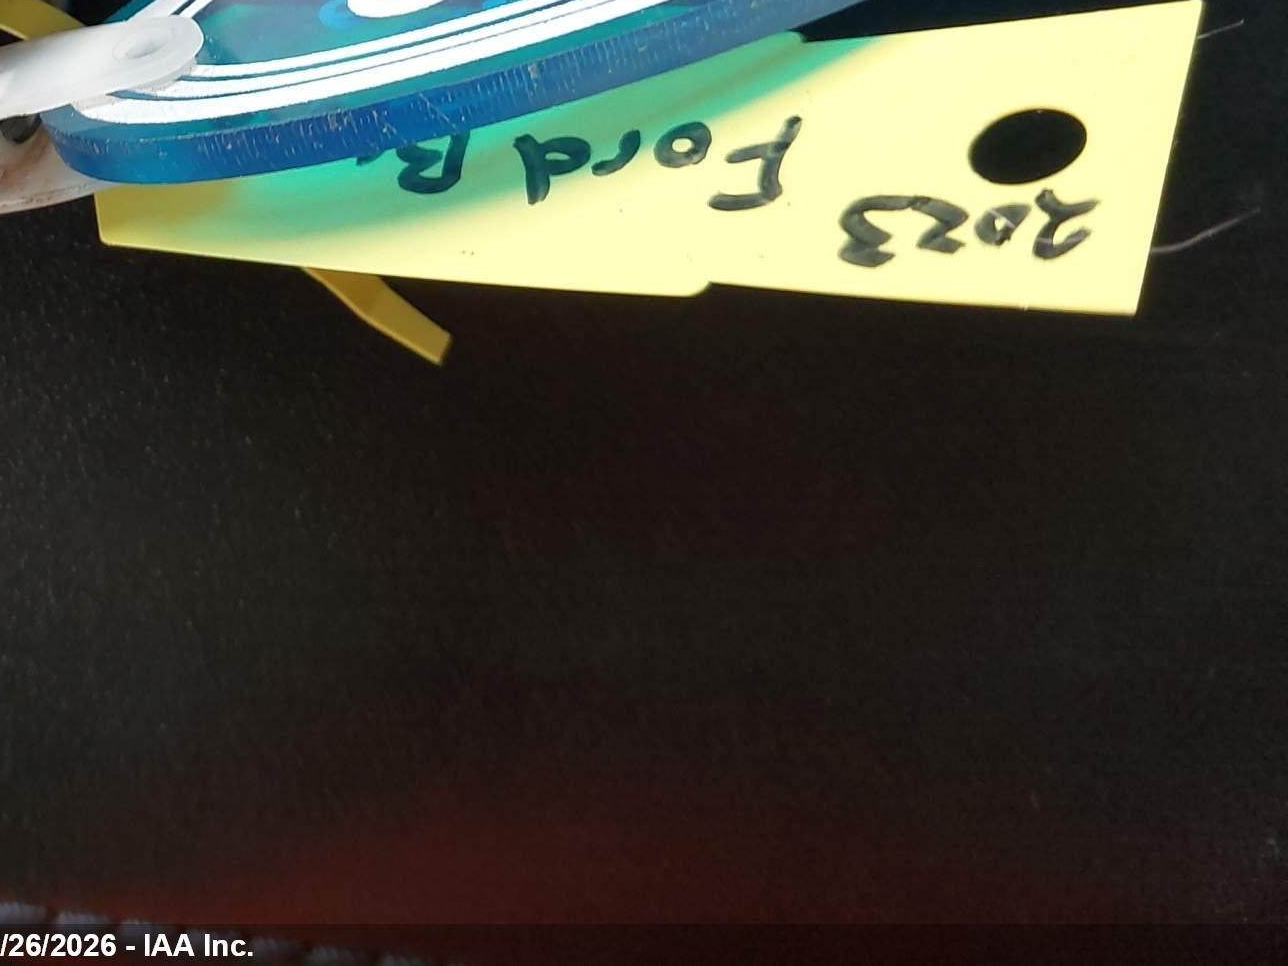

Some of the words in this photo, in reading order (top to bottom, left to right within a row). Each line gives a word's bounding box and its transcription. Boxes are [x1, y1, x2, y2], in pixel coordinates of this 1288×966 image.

[355, 129, 470, 194] B
[511, 115, 802, 213] Ford
[838, 188, 1100, 268] 2023
